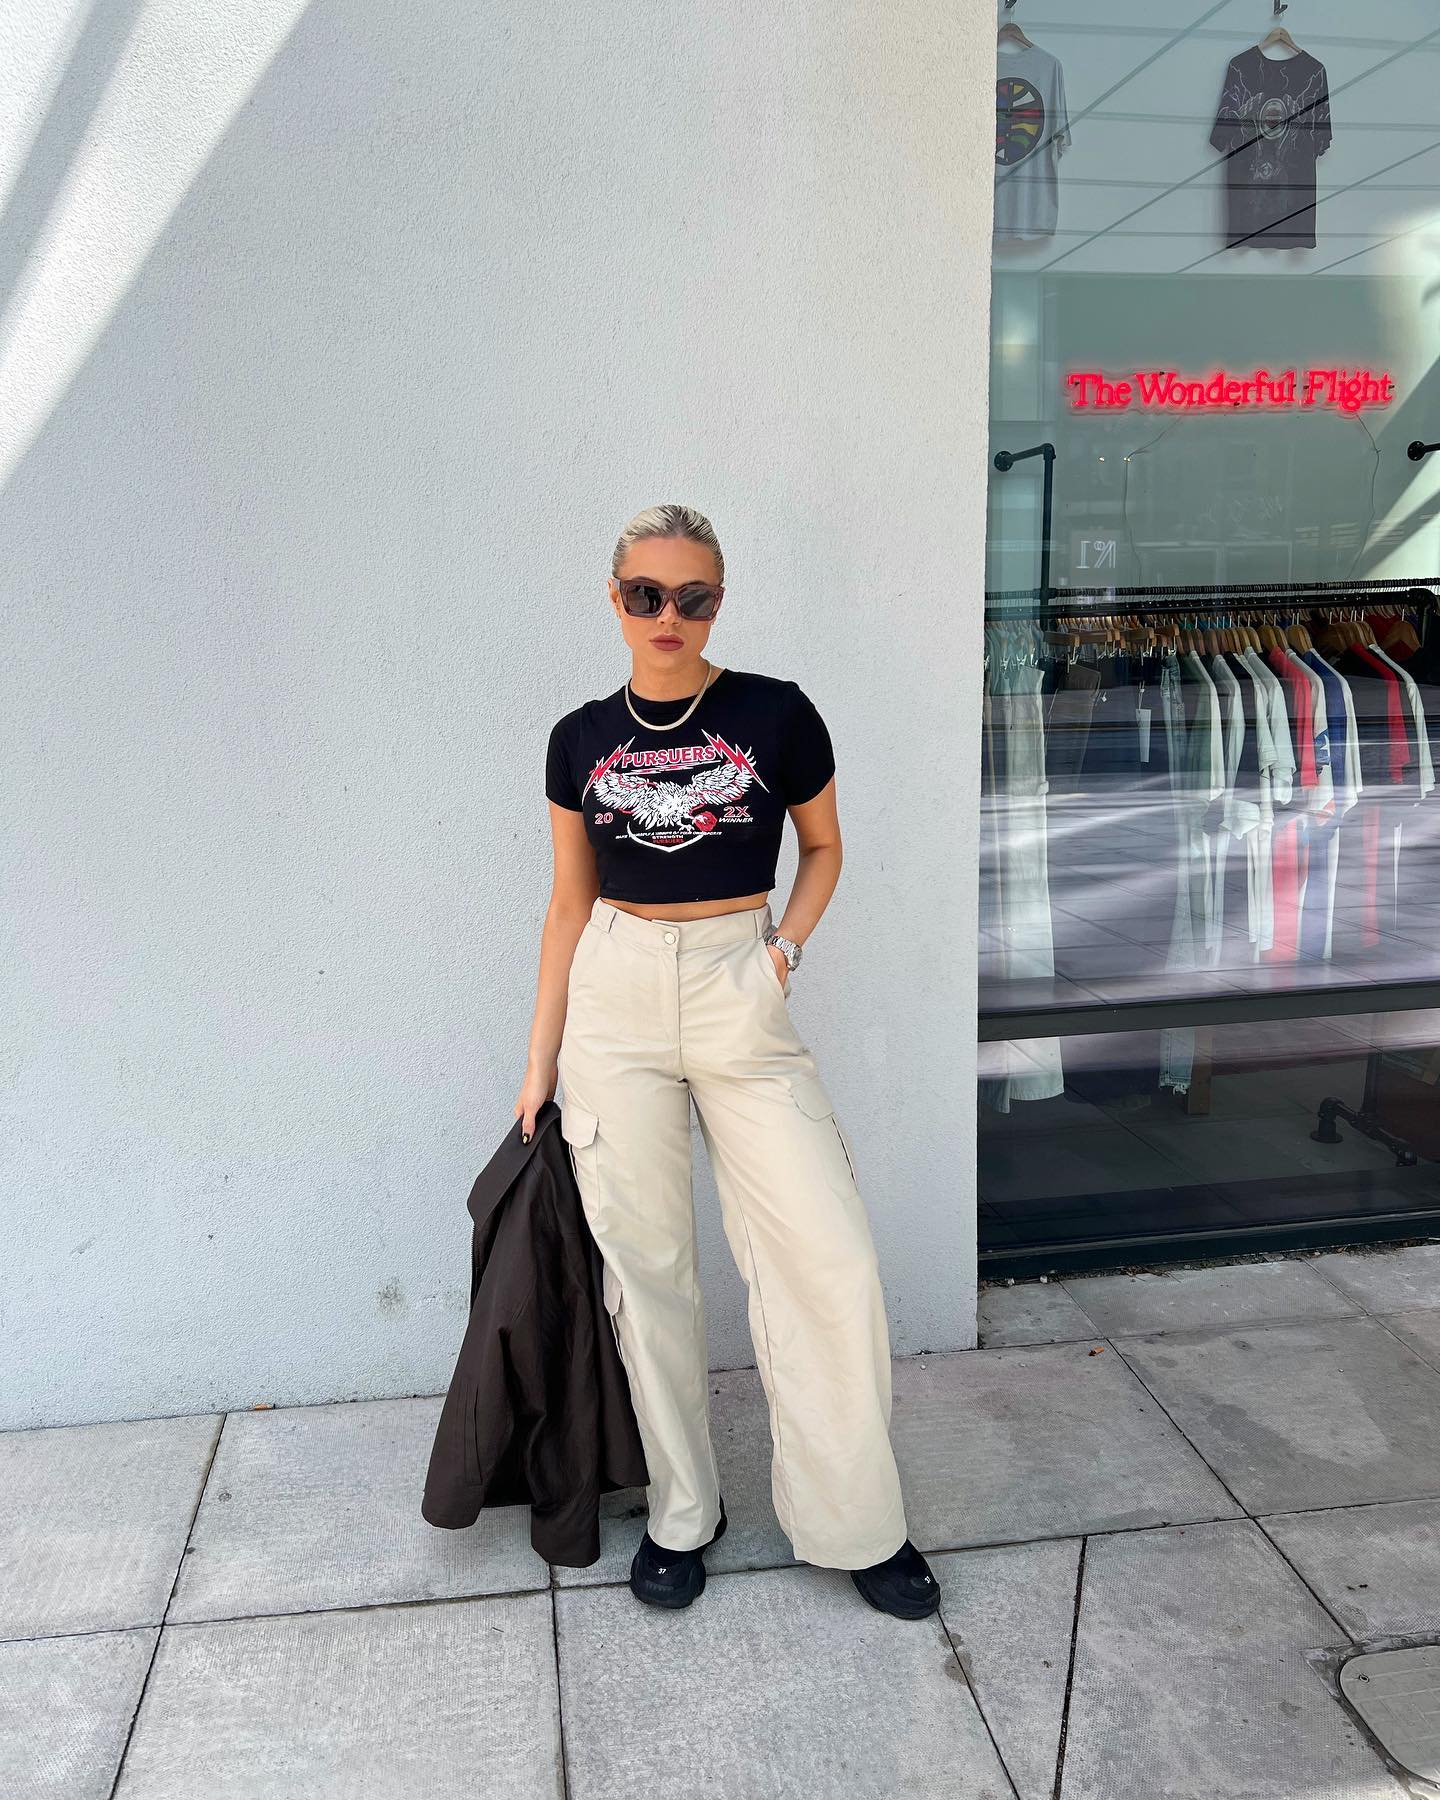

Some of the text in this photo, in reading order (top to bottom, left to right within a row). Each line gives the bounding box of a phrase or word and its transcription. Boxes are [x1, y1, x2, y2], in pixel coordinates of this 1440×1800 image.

[1068, 370, 1394, 412] The Wonderful Flight
[621, 746, 716, 769] PURSUERS
[594, 812, 614, 825] 20
[723, 805, 751, 818] 2X
